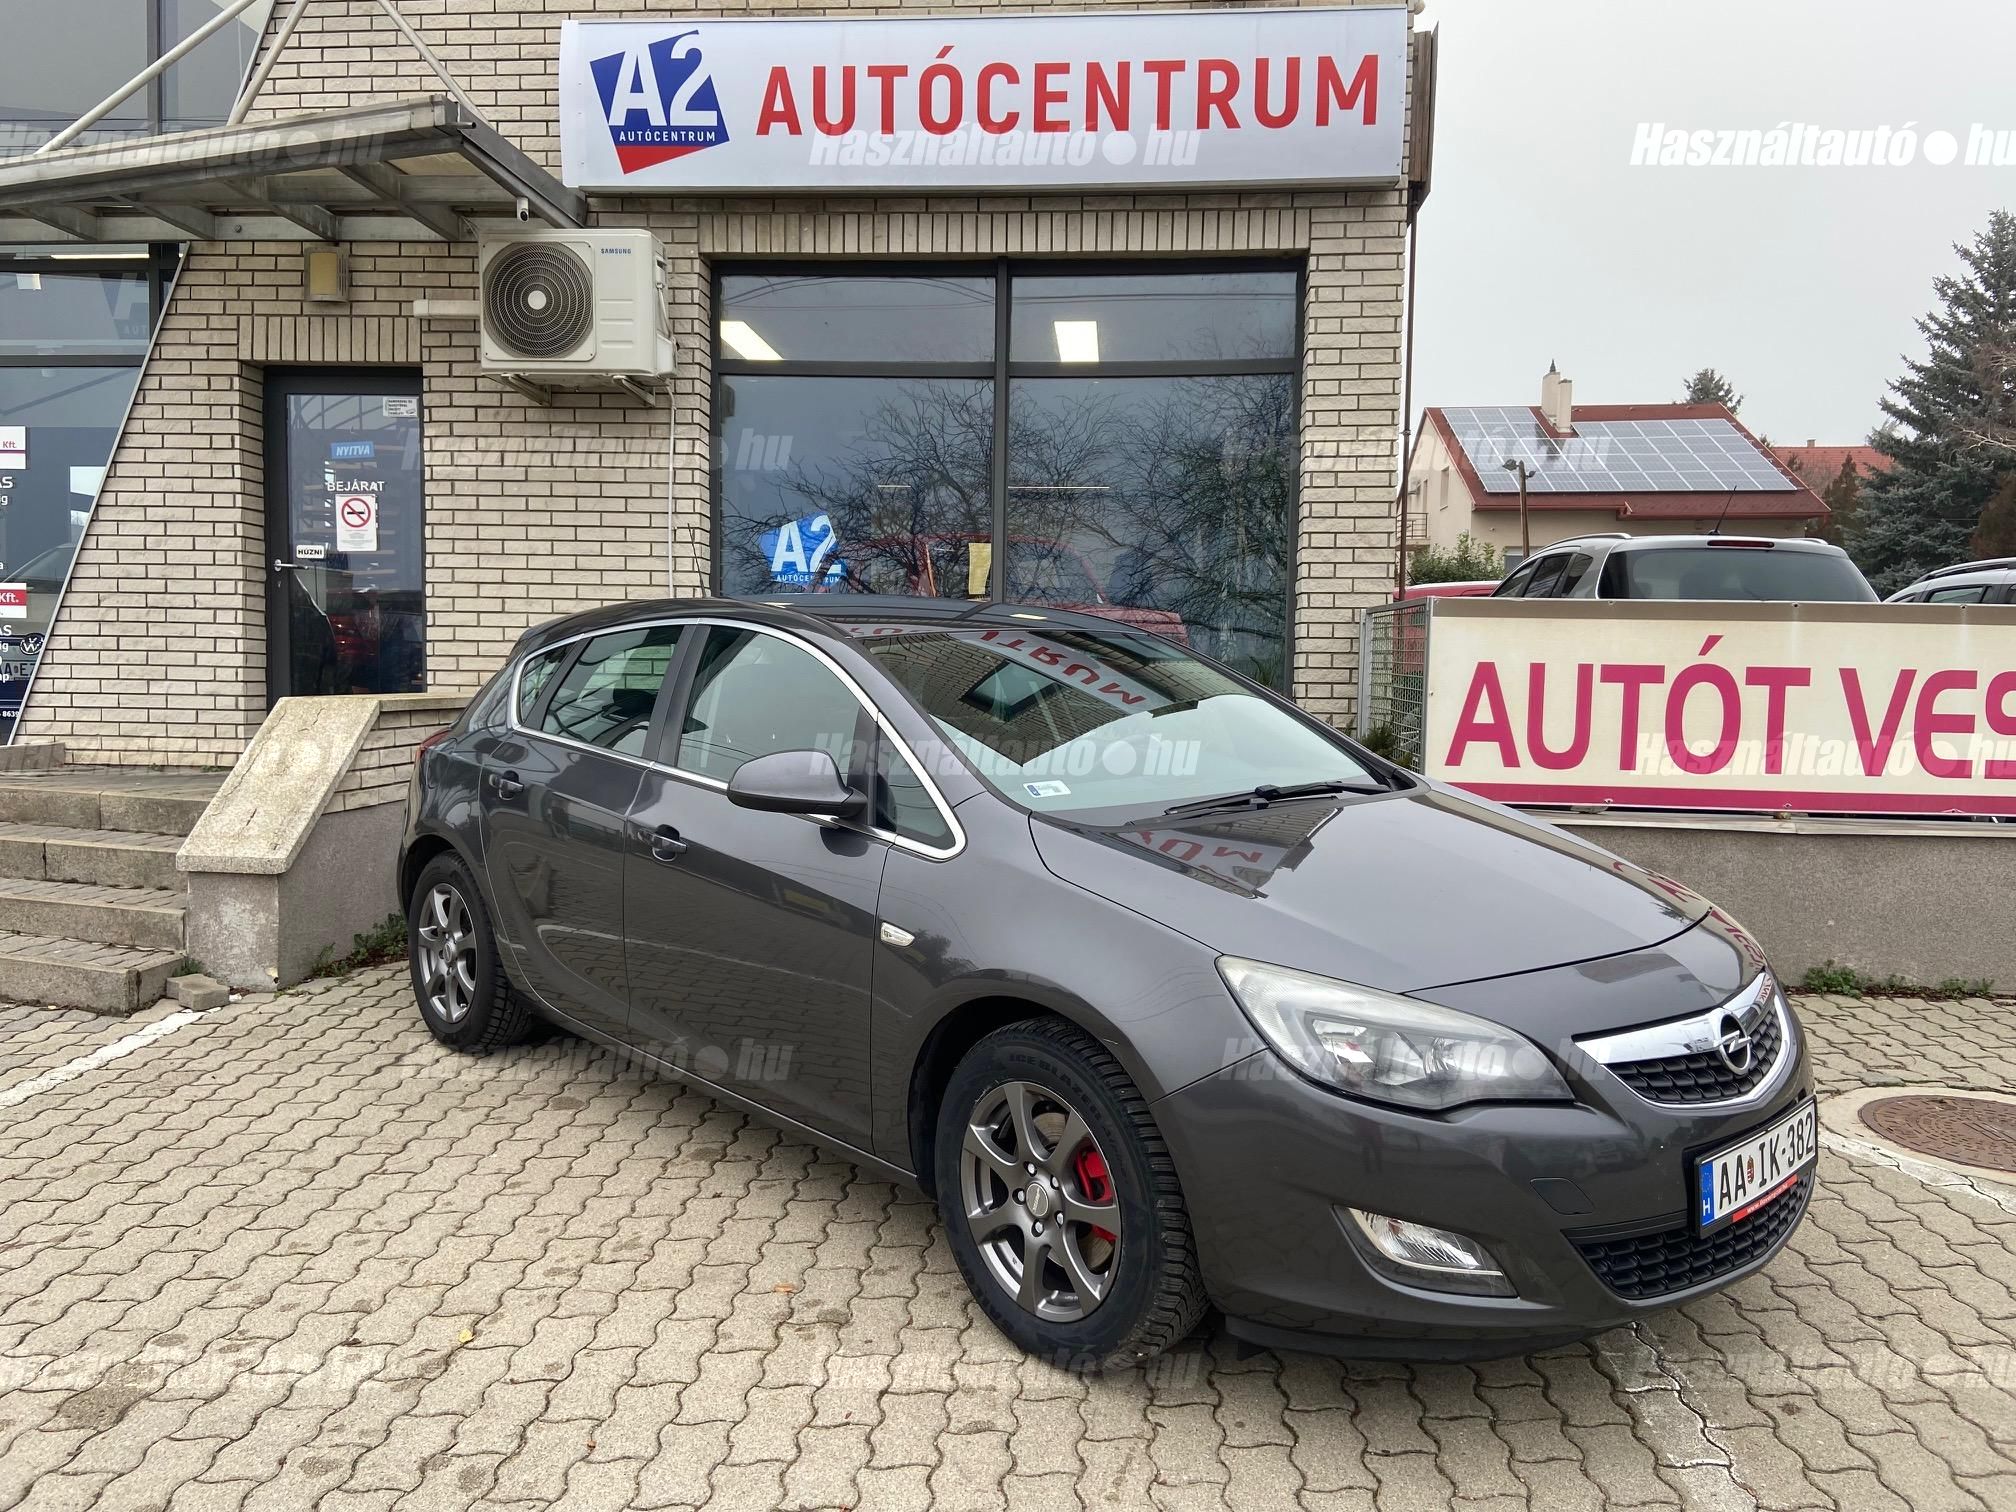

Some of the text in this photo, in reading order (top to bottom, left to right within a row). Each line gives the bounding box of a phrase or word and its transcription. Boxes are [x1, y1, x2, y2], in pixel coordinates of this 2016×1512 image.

[608, 33, 718, 127] A2
[757, 46, 1377, 135] AUTÓCENTRUM
[619, 129, 716, 142] AUTÓCENTRUM
[336, 445, 370, 456] NYITVA
[327, 479, 385, 491] BEJÁRAT
[297, 546, 323, 555] HÚZNI
[1446, 635, 1811, 775] AUTÓT
[1719, 1153, 1747, 1210] AA
[1758, 1111, 1814, 1188] IK-382
[1702, 1197, 1711, 1217] H
